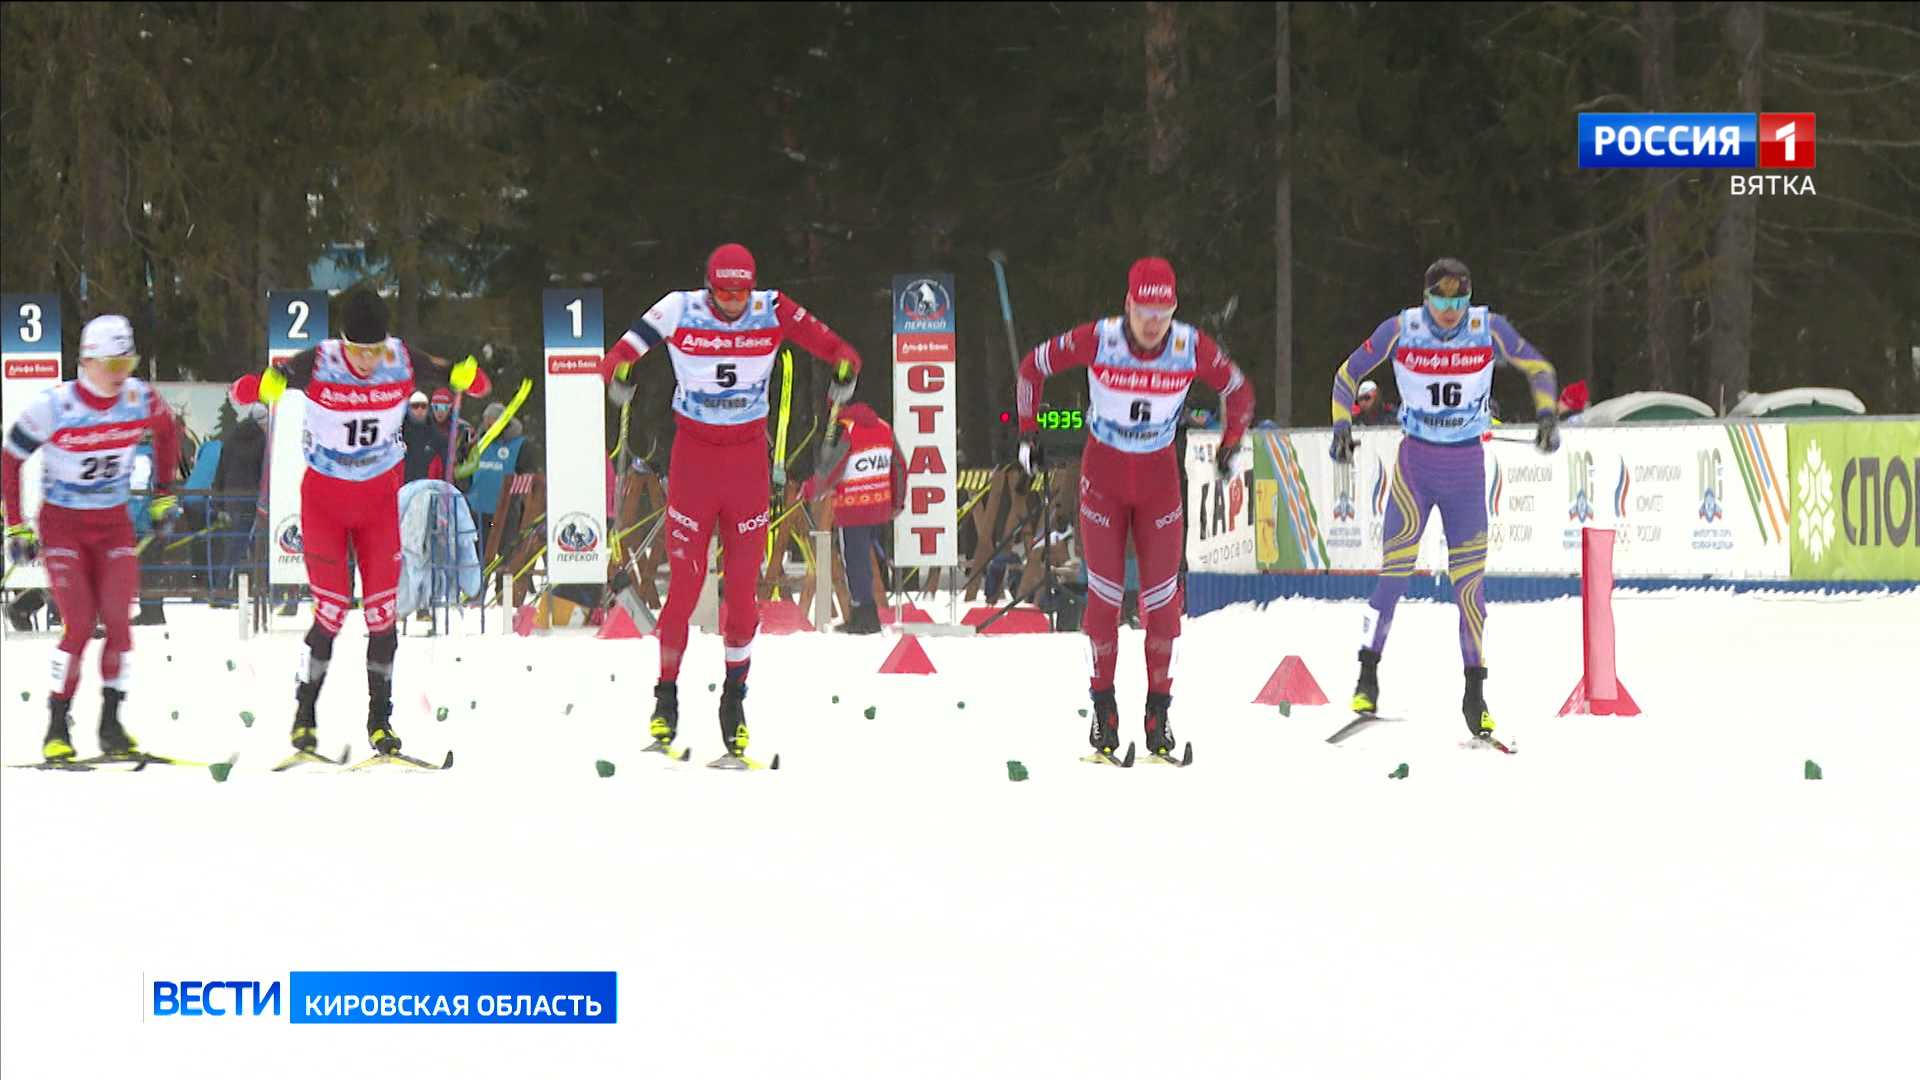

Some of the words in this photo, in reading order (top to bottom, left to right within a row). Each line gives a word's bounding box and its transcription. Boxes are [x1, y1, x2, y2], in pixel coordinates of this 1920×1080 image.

[19, 302, 43, 343] 3
[287, 300, 310, 339] 2
[565, 299, 582, 338] 1
[904, 321, 947, 330] ПЕРЕКОП
[682, 334, 732, 350] Альфа
[735, 336, 773, 348] Банк
[902, 342, 928, 354] Альфа
[929, 341, 950, 352] Банк
[551, 360, 577, 372] Альфа
[577, 360, 598, 369] Банк
[1405, 353, 1449, 370] Альфа
[1450, 353, 1485, 366] Банк
[717, 363, 737, 388] 5
[1100, 370, 1149, 388] Альфа
[1151, 373, 1188, 390] Банк
[320, 387, 369, 405] Альфа
[369, 388, 404, 402] Банк
[1426, 382, 1462, 407] 16
[1129, 399, 1153, 422] 6
[343, 418, 378, 446] 15
[81, 455, 119, 480] 25
[907, 365, 948, 555] СТАРТ
[556, 553, 599, 562] ПЕРЕКОП
